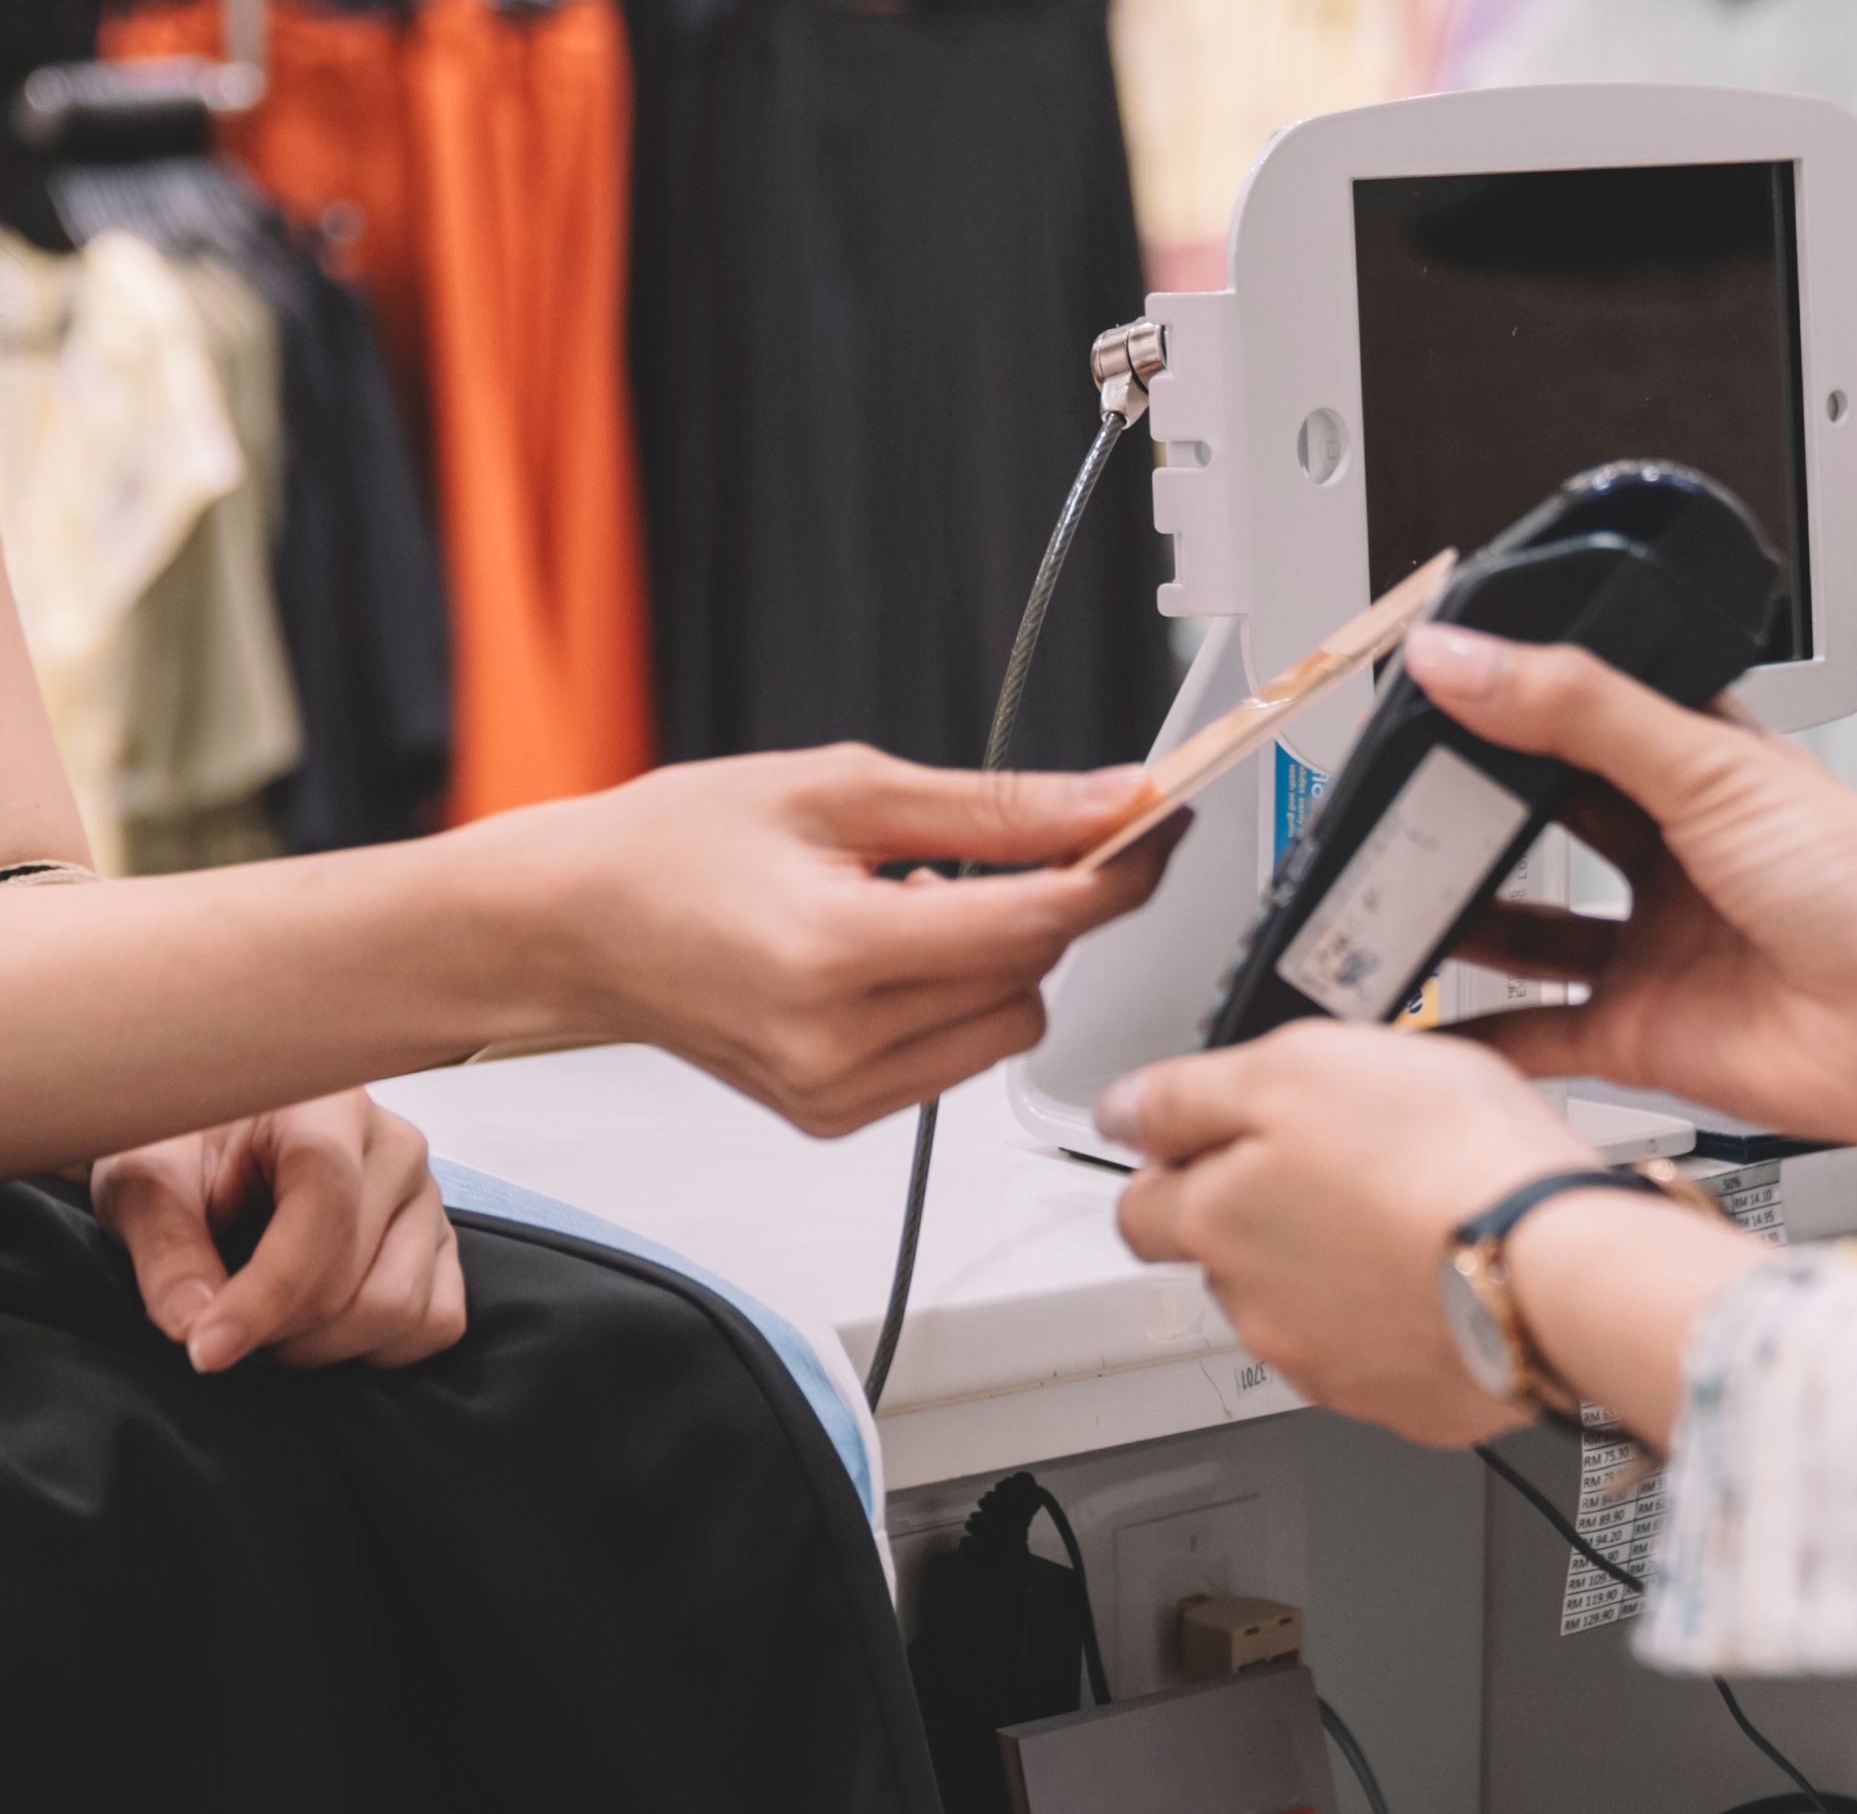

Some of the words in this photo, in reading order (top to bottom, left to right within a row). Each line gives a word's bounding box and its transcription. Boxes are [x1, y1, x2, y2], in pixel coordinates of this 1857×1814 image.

[1584, 1454, 1601, 1468] RM
[1584, 1476, 1600, 1489] RM
[1582, 1496, 1599, 1509] RM
[1578, 1517, 1596, 1530] RM
[1599, 1509, 1625, 1526] 89.90
[1568, 1577, 1586, 1590] RM
[1566, 1597, 1583, 1610] RM
[1585, 1589, 1618, 1607] 119.90
[1564, 1617, 1580, 1631] RM
[1582, 1609, 1614, 1628] 129.90
